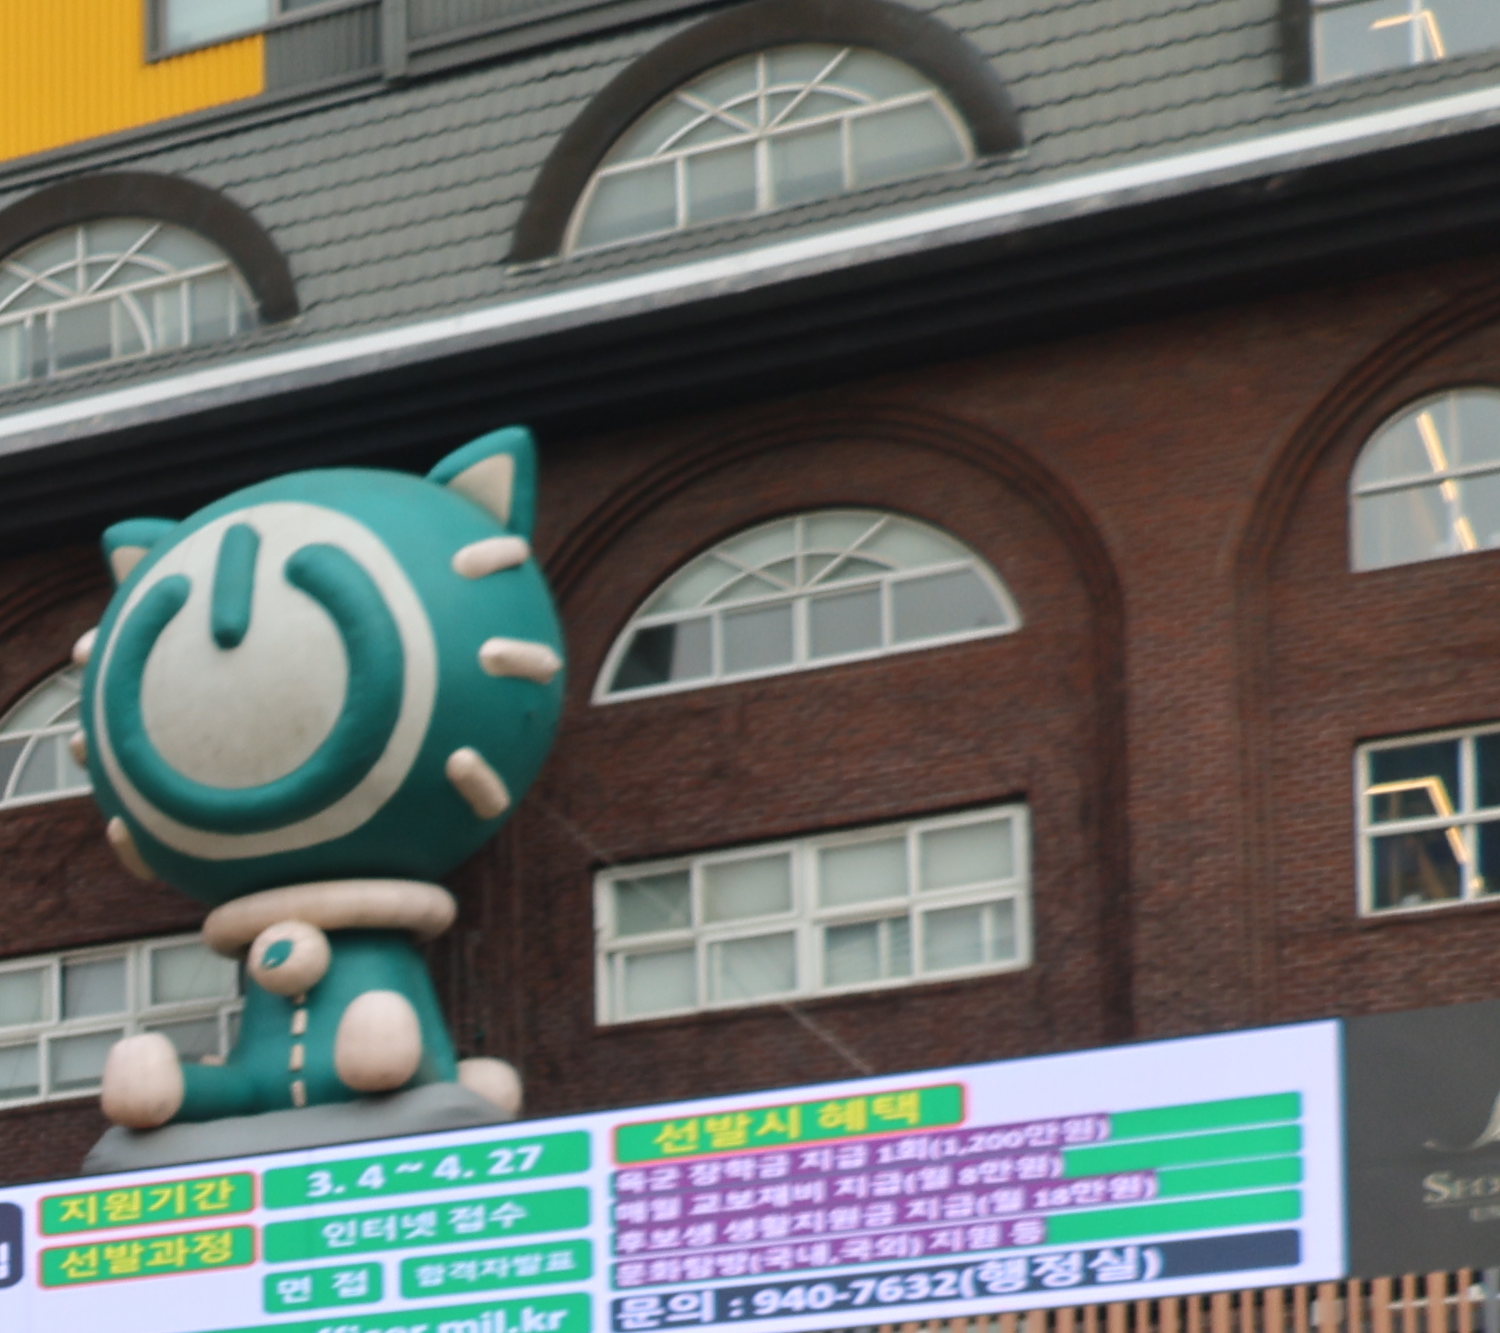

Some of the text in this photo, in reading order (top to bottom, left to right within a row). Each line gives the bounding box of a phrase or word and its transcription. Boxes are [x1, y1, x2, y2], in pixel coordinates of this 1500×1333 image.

[653, 1090, 921, 1153] 선발시 혜택
[59, 1179, 235, 1224] 지원기간
[447, 1200, 527, 1234] 접수
[59, 1232, 233, 1279] 선발과정
[616, 1289, 717, 1330] 문의
